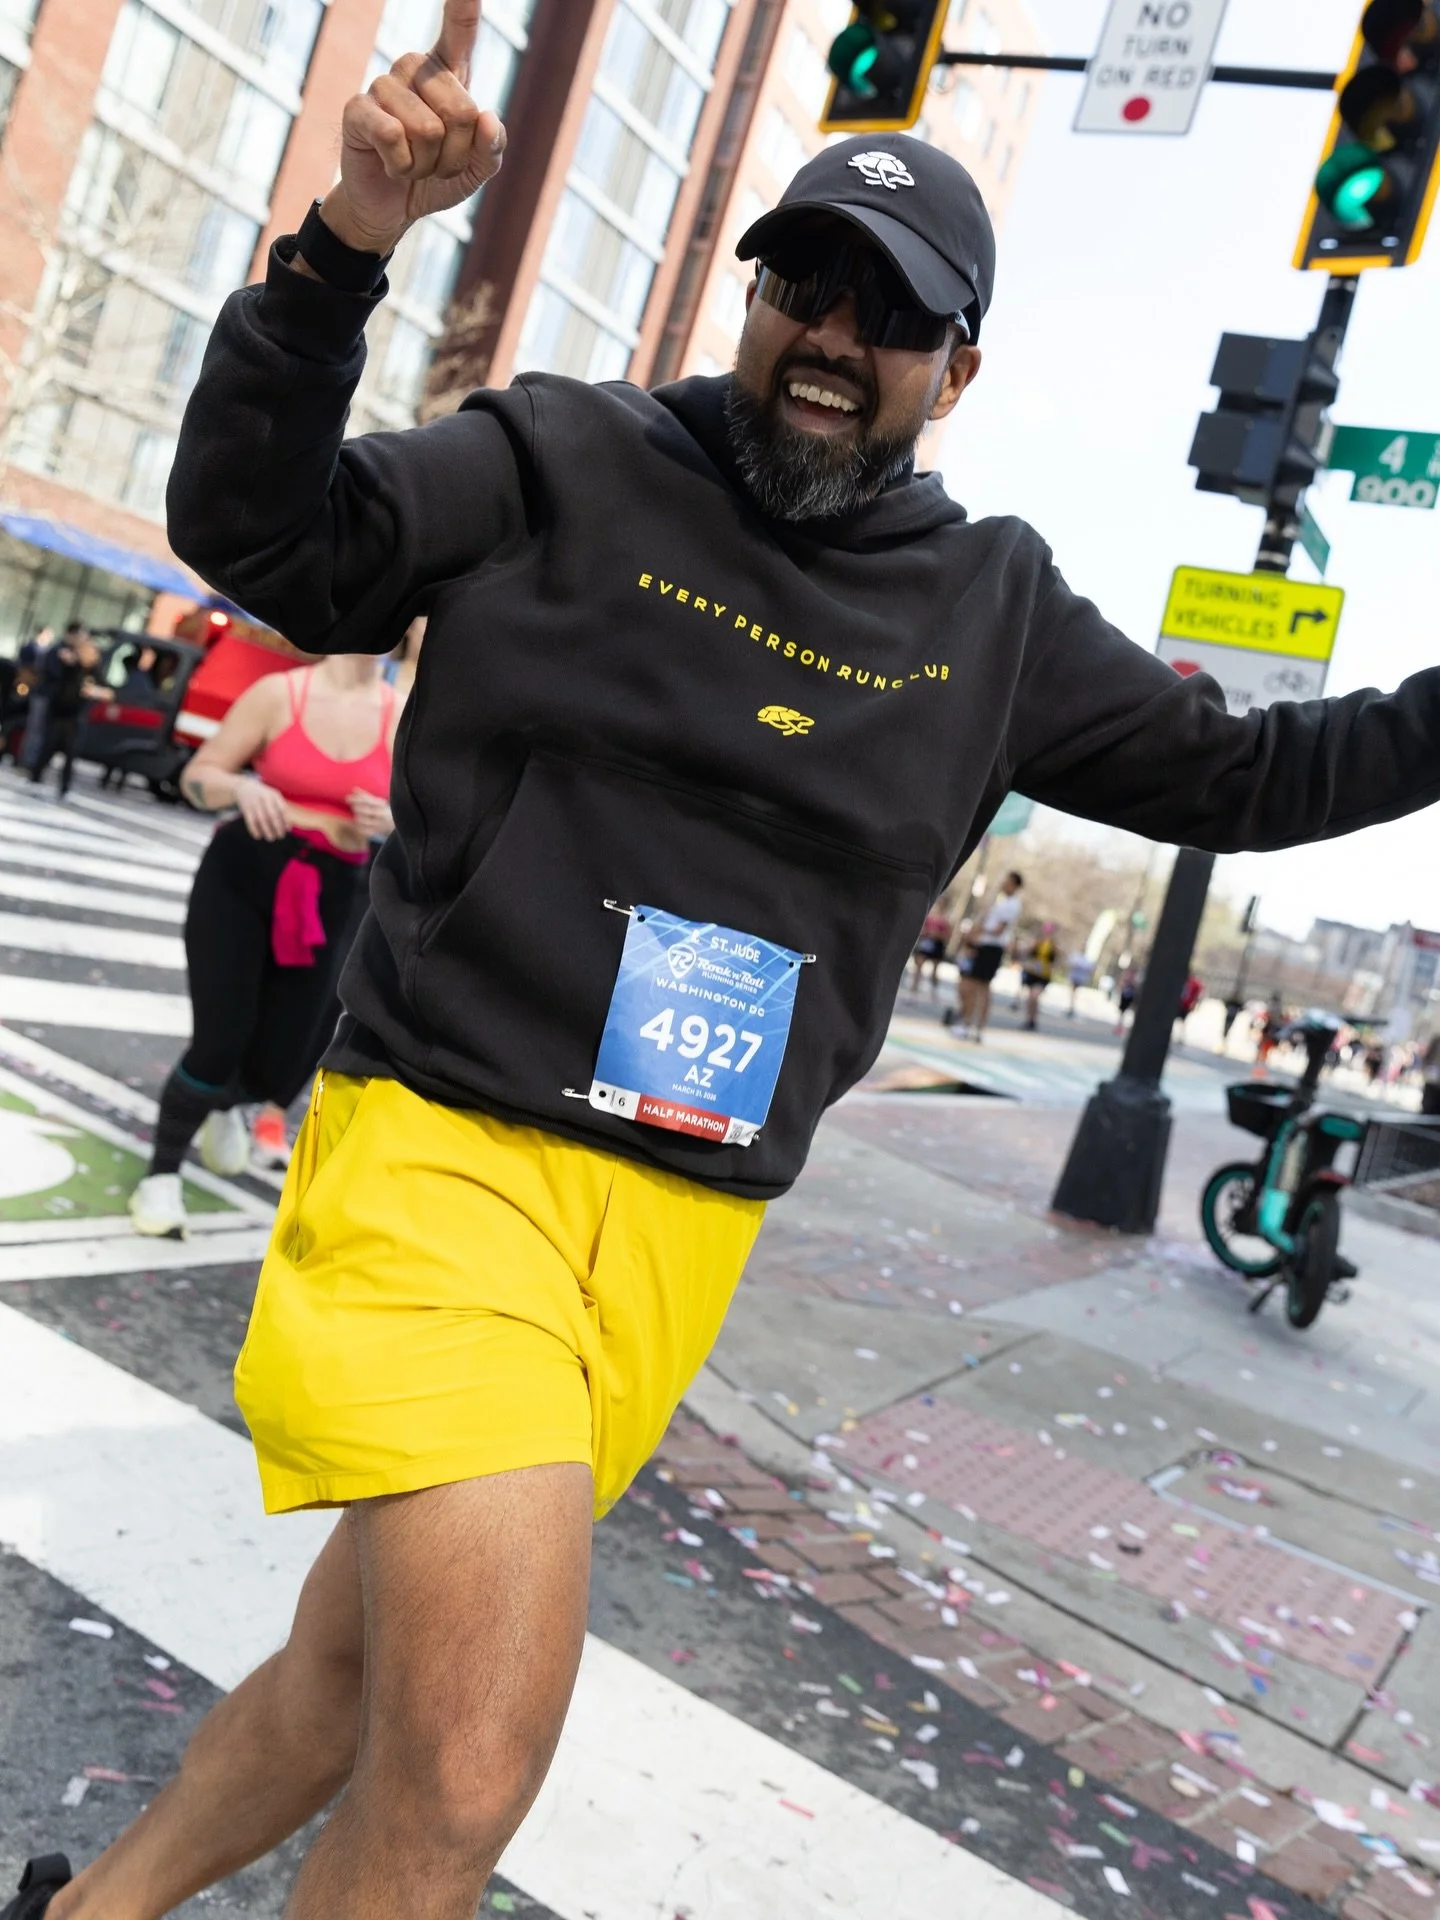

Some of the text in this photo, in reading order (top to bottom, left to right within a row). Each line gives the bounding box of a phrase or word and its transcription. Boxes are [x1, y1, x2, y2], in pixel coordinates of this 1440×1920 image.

[1136, 1, 1192, 29] NO
[1122, 34, 1191, 58] TURN
[1096, 65, 1197, 89] ON RED
[1379, 435, 1408, 474] 4
[1182, 577, 1282, 611] TURNING
[639, 573, 726, 617] EVERY
[735, 615, 830, 672] PERSON
[1173, 608, 1279, 640] VEHICLES
[711, 936, 761, 964] ST. JUDE
[656, 977, 765, 1017] WASHINGTON DC
[640, 1008, 763, 1073] 4927
[672, 1083, 696, 1096] MARCH
[684, 1065, 714, 1088] AZ
[618, 1097, 626, 1107] 6
[643, 1103, 725, 1133] HALF MARATHON
